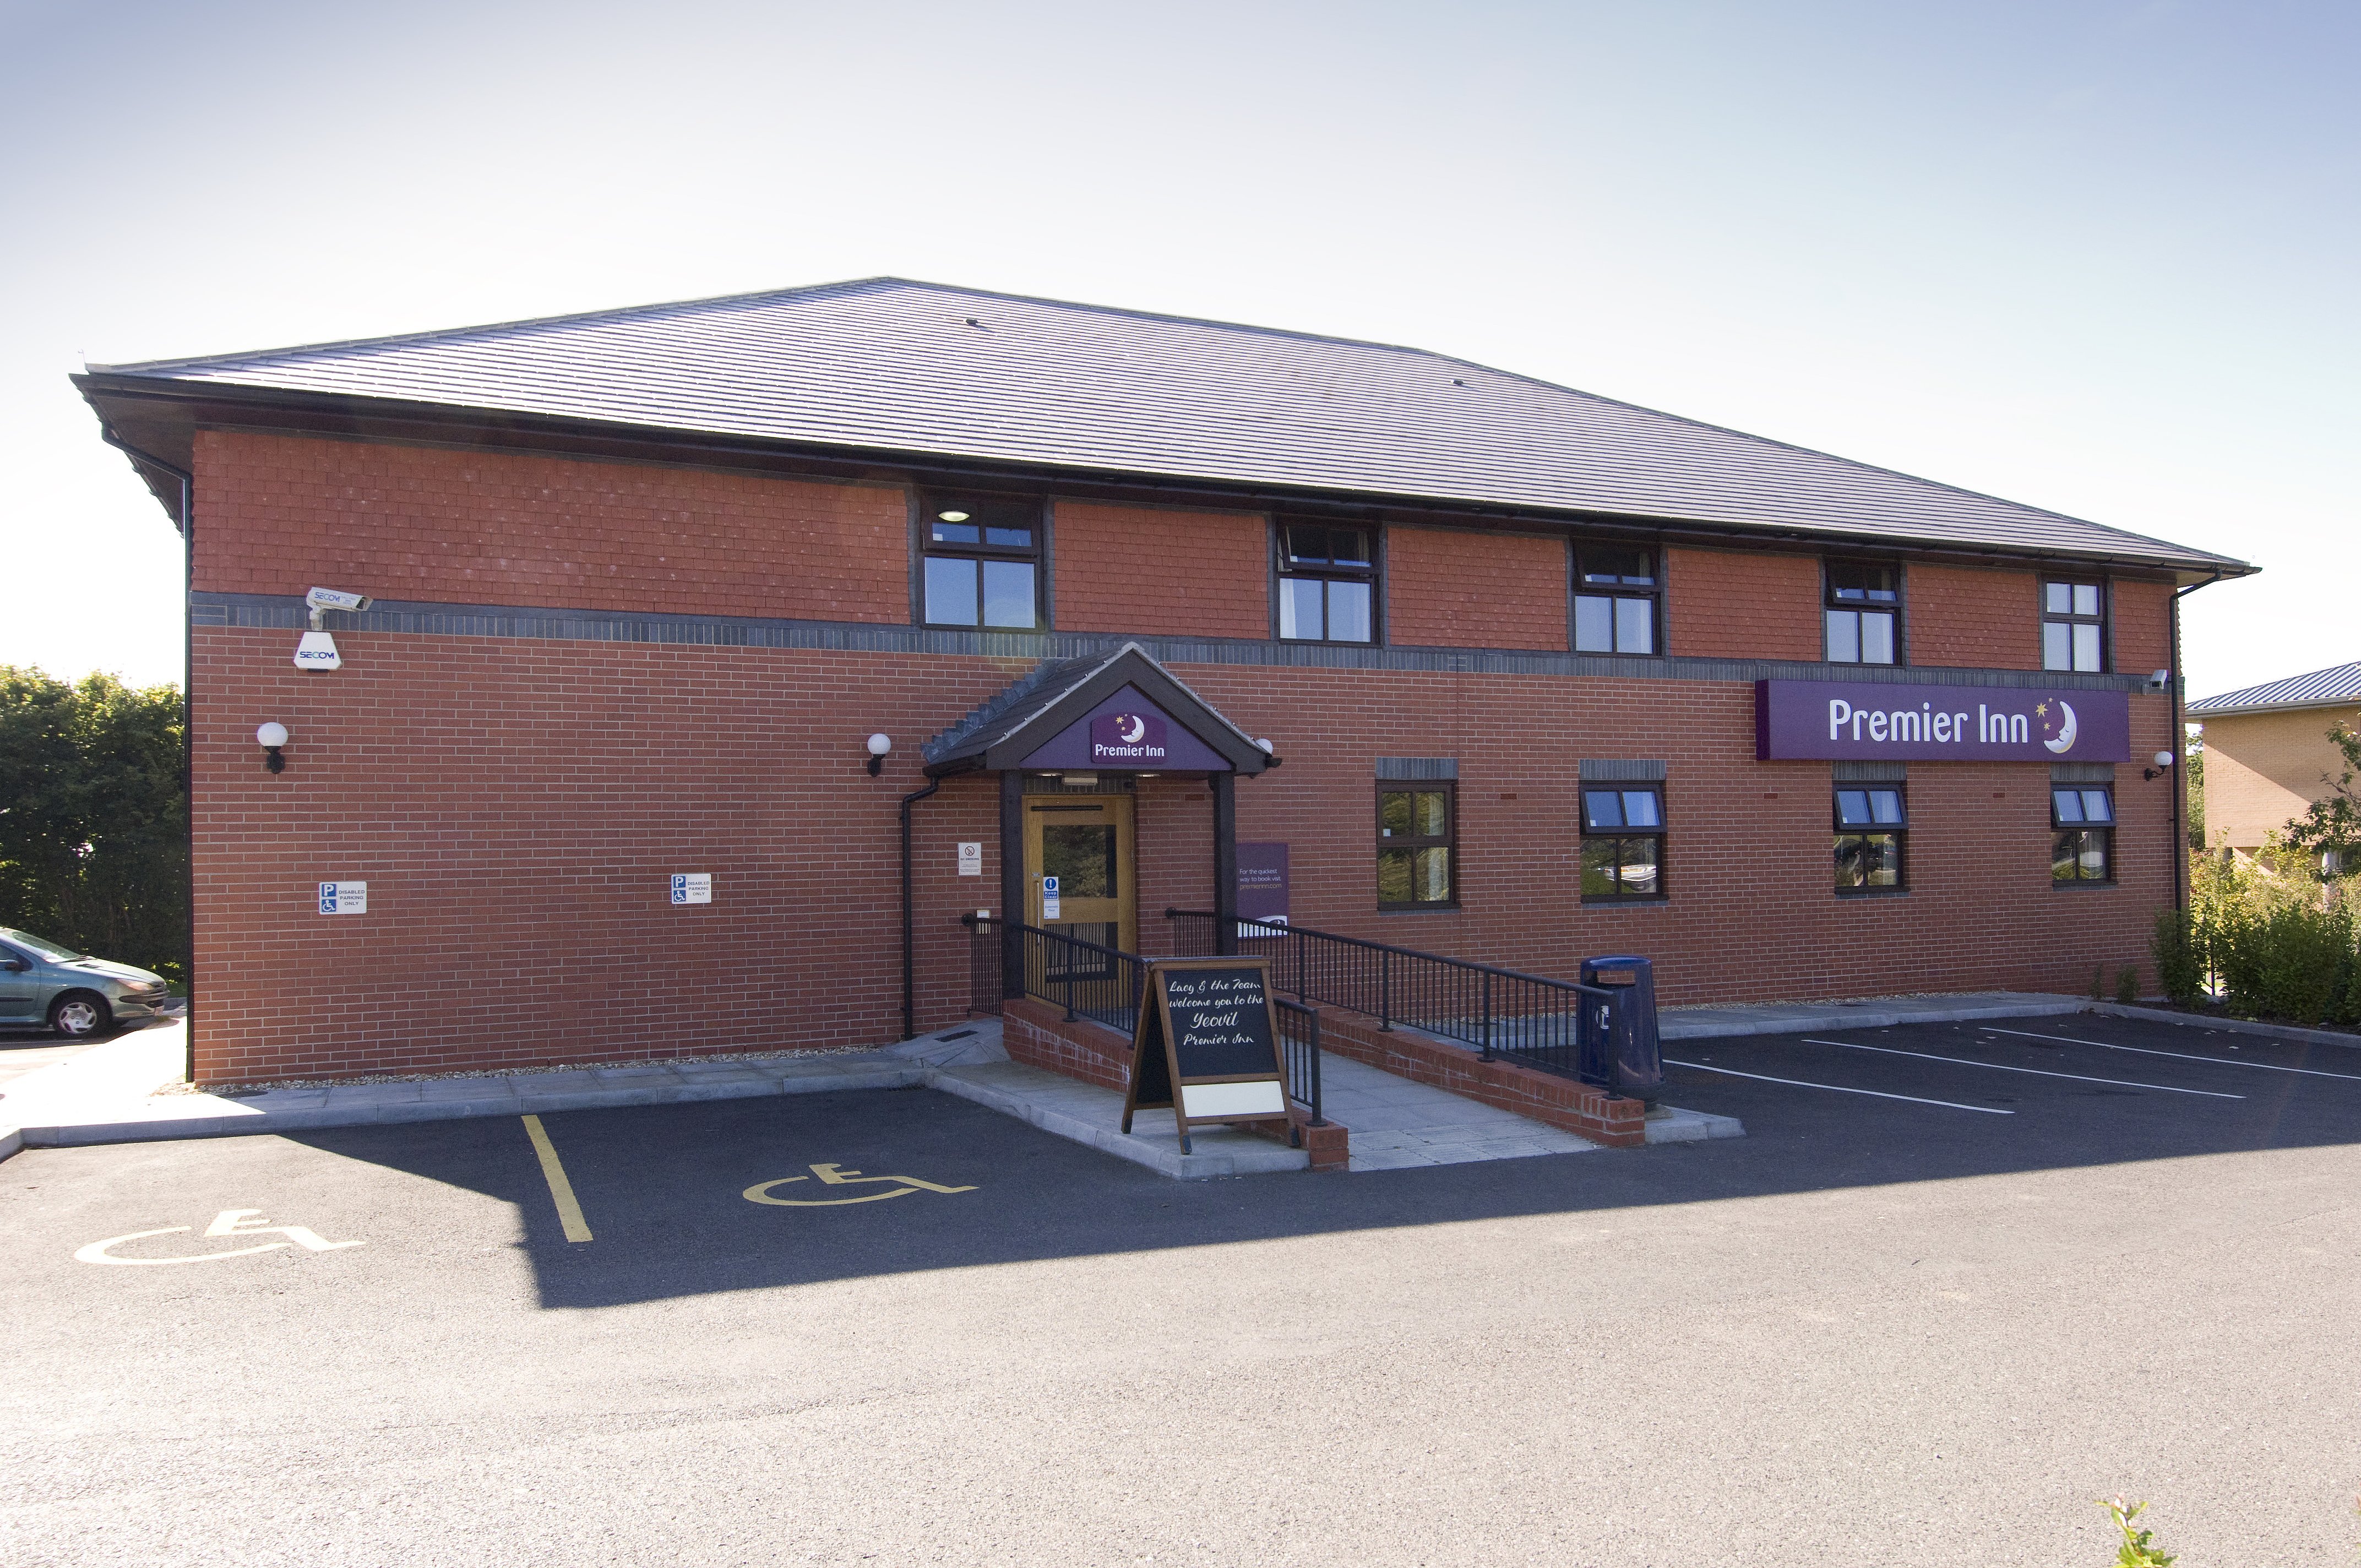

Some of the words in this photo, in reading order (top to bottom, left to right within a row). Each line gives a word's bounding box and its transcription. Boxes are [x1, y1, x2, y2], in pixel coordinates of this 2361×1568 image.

[314, 591, 341, 602] SECOM
[1829, 699, 1968, 742] Premier
[1979, 704, 2028, 743] Inn
[1095, 744, 1144, 756] Premier
[1146, 744, 1165, 756] Inn
[675, 876, 684, 888] P
[324, 884, 334, 896] P
[1196, 980, 1206, 994] &
[1211, 980, 1230, 990] the
[1232, 978, 1261, 990] Team
[1169, 997, 1211, 1008] welcome
[1215, 999, 1232, 1009] you
[1234, 995, 1245, 1005] to
[1247, 994, 1264, 1004] the
[1190, 1011, 1239, 1028] Yeovil
[1183, 1033, 1227, 1046] Premier
[1232, 1033, 1254, 1044] Inn
